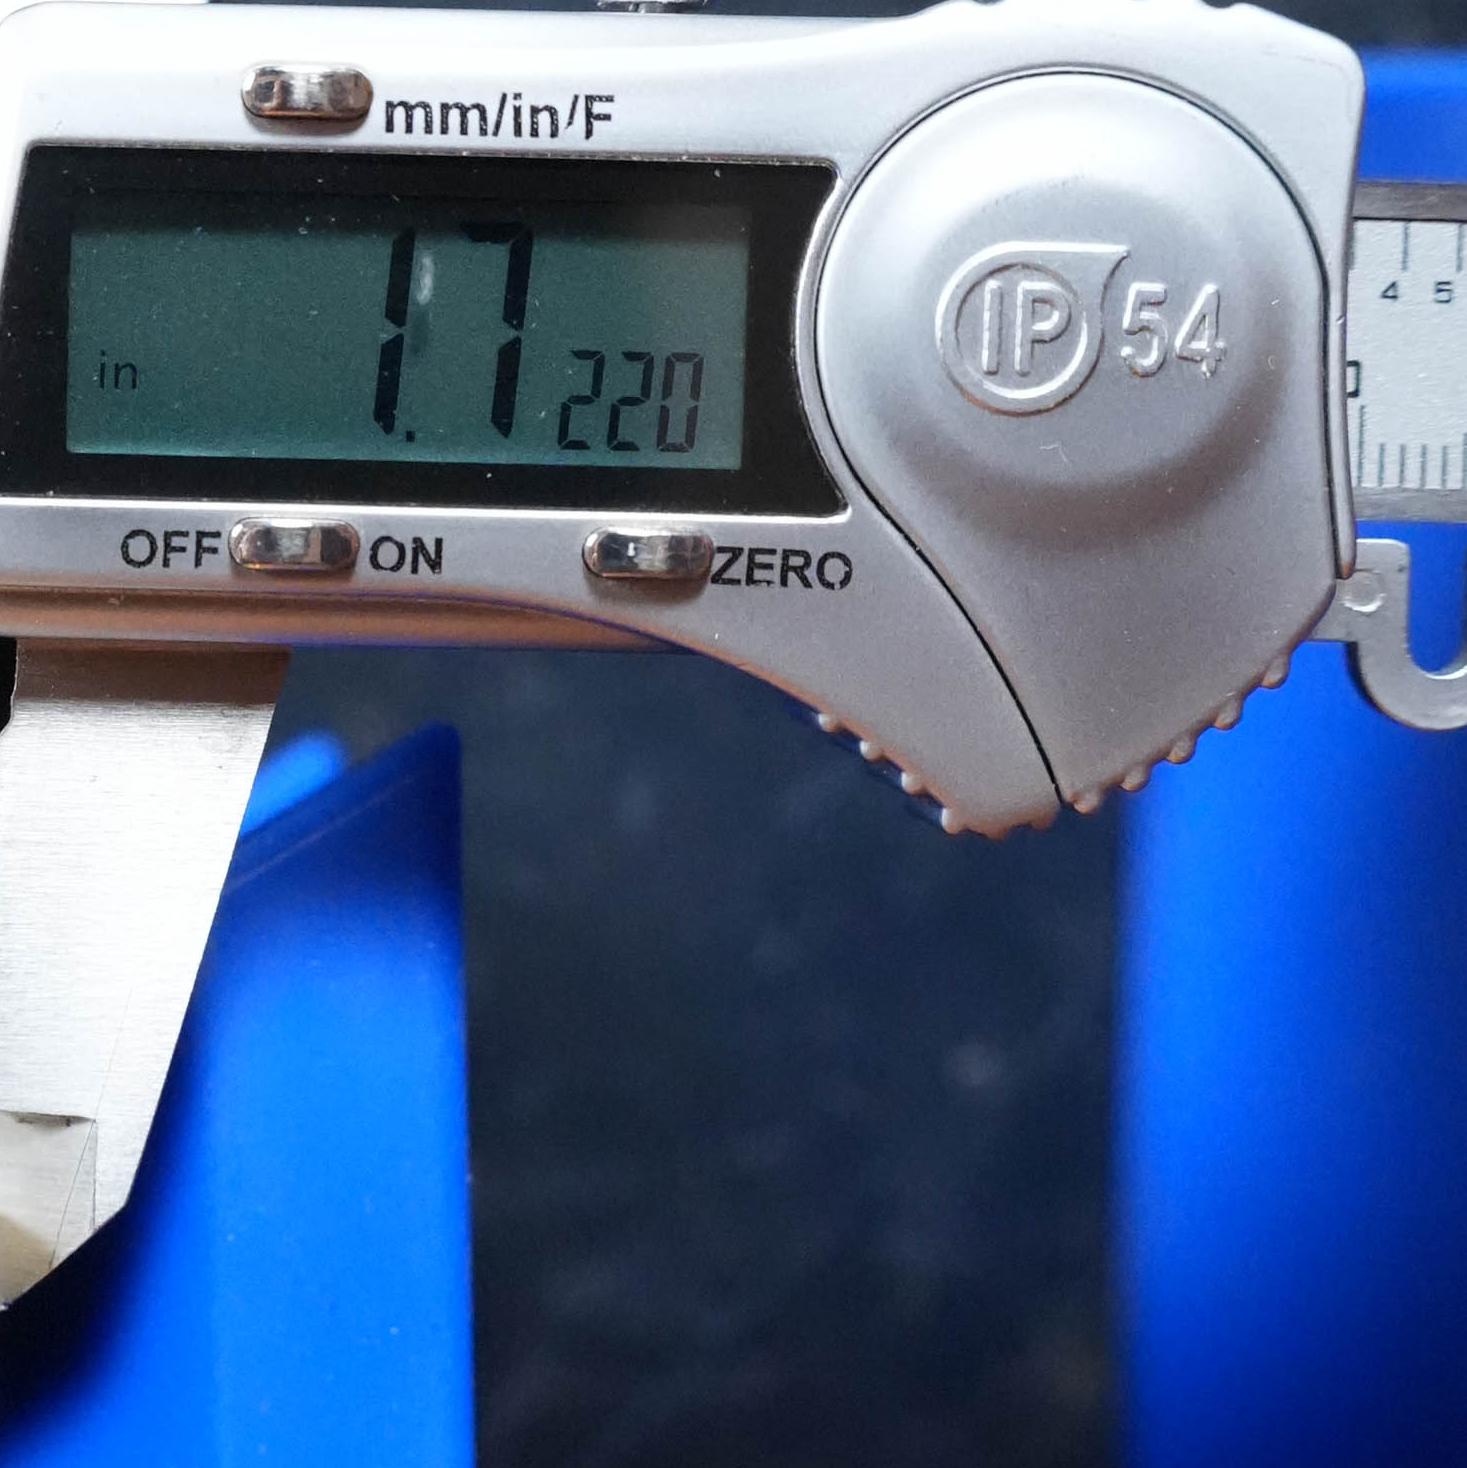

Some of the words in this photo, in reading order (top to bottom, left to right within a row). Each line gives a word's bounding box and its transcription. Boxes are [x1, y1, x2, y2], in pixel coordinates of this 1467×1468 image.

[384, 92, 615, 140] mm/in/F
[1380, 281, 1399, 300] 4
[1434, 281, 1454, 304] 5
[1120, 282, 1228, 379] 54
[97, 354, 139, 391] in
[120, 529, 223, 569] OFF
[369, 535, 445, 576] ON
[710, 546, 854, 591] ZERO
